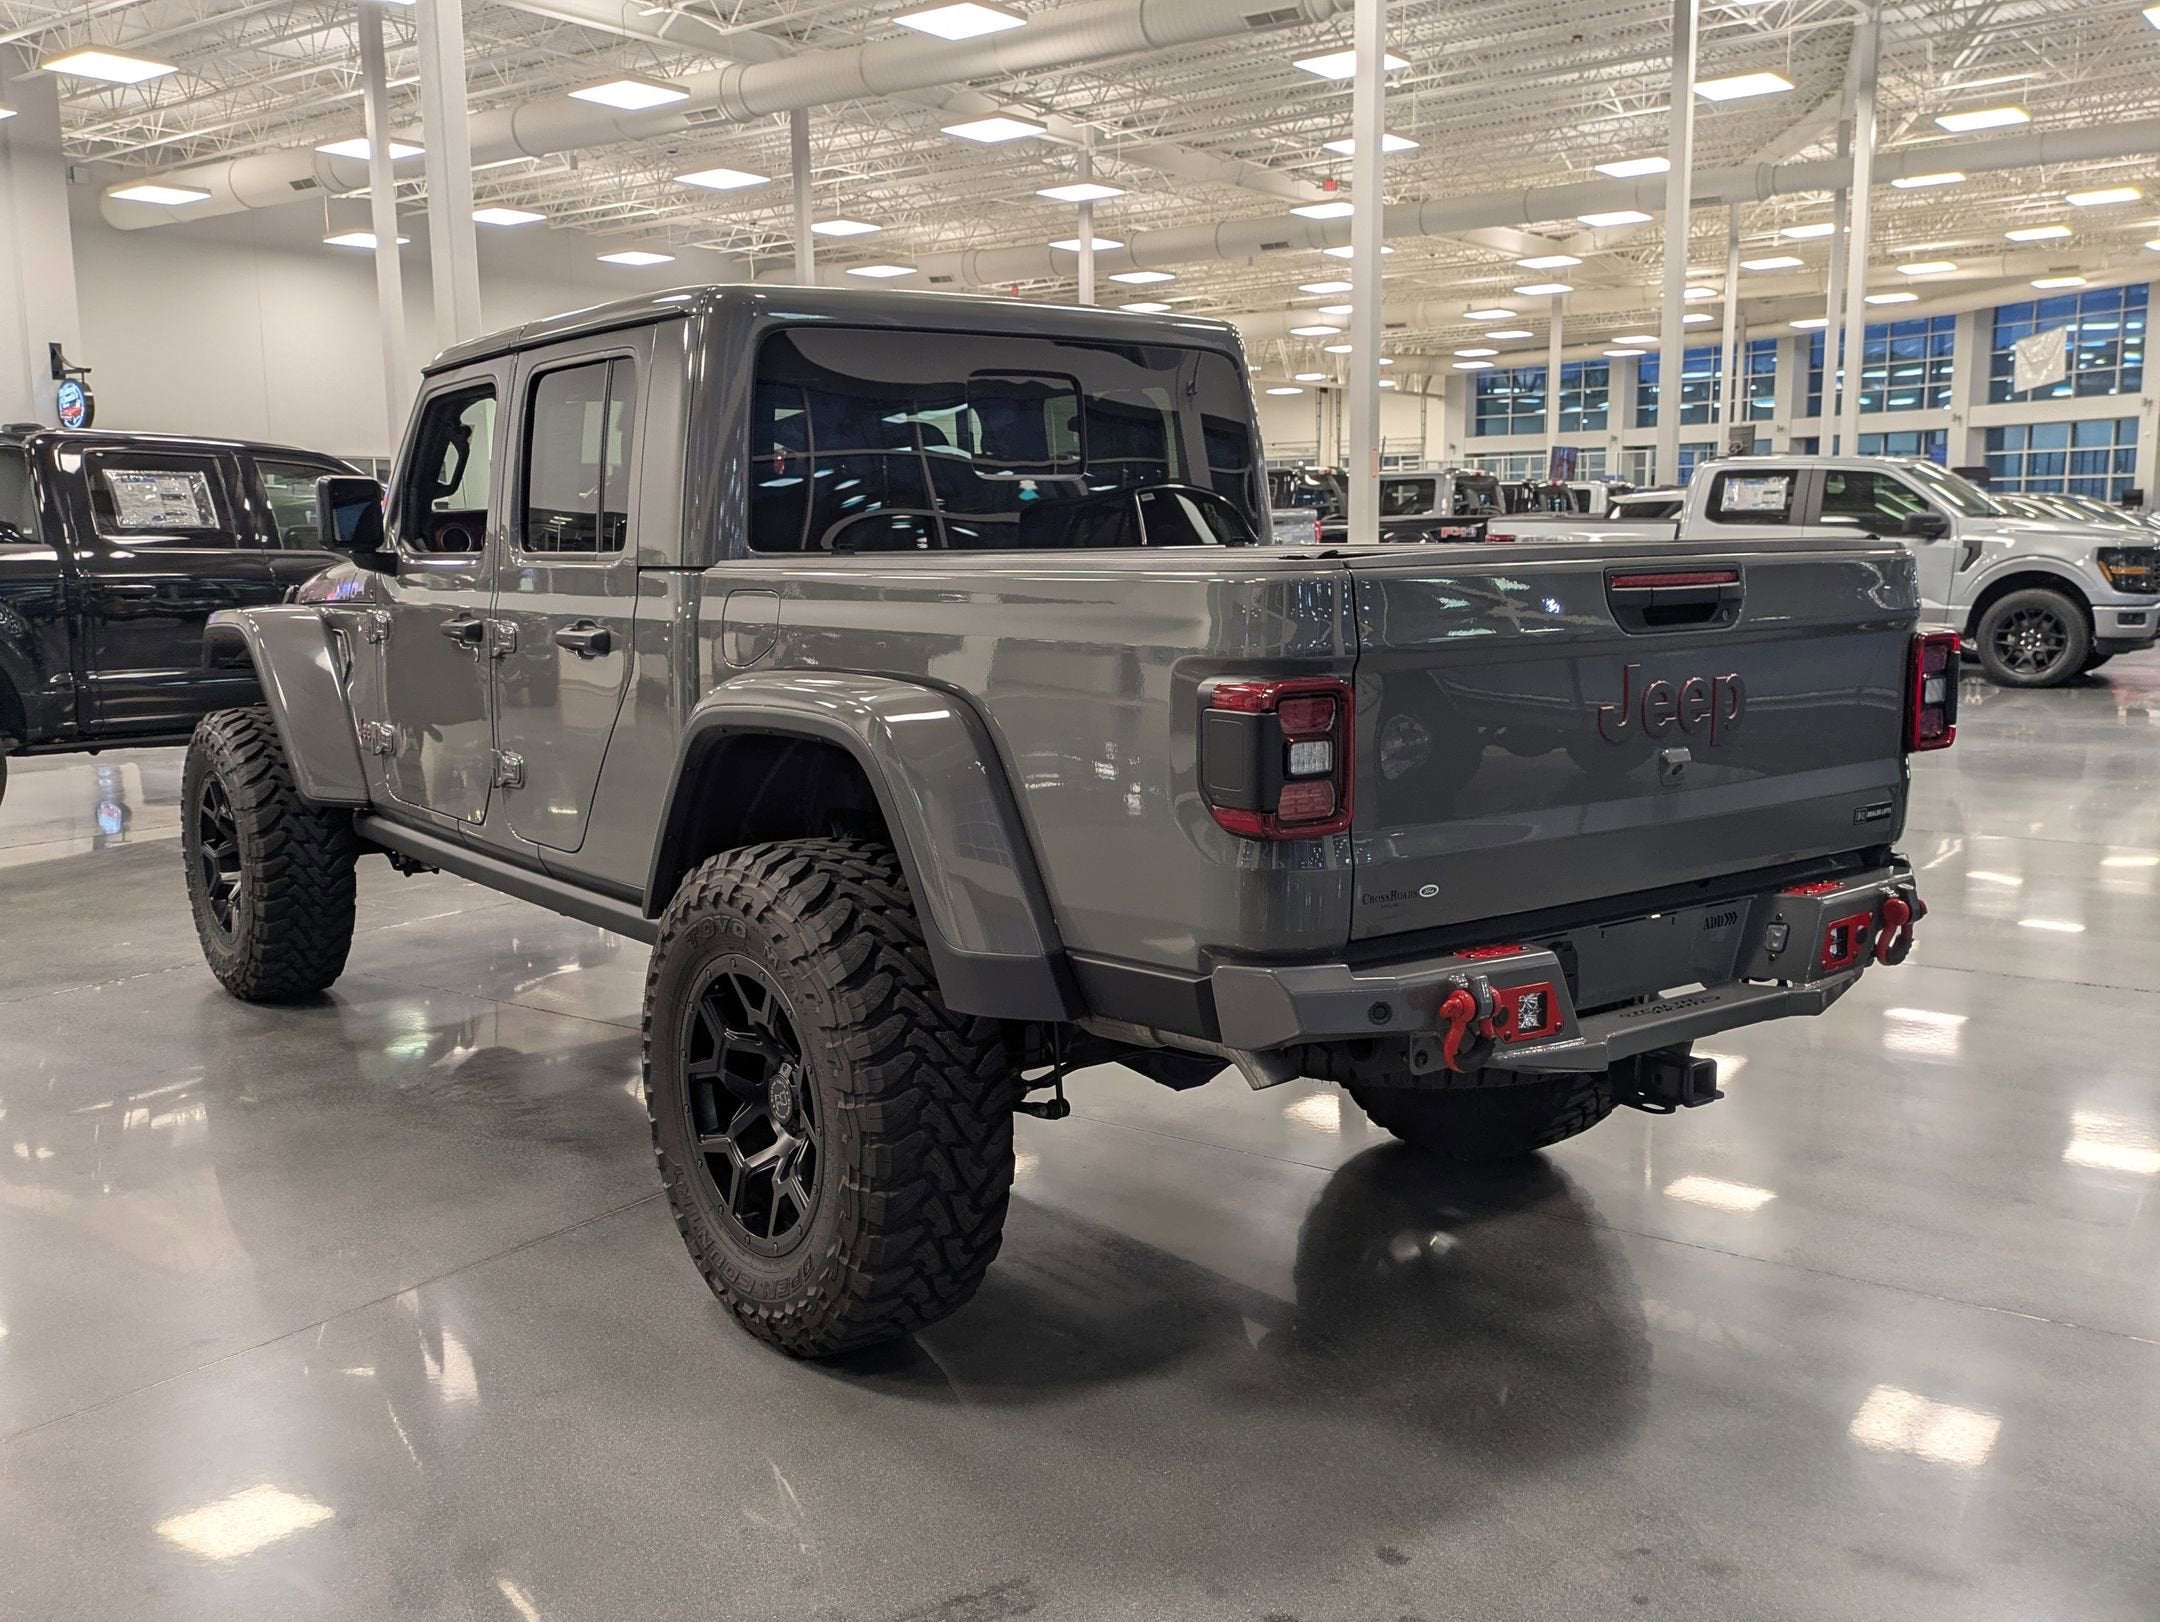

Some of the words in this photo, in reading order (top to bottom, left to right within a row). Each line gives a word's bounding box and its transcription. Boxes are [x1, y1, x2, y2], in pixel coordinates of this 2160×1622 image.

[1598, 664, 1746, 747] Jeep
[685, 914, 747, 947] TOYO
[1703, 914, 1725, 931] ADD
[664, 1155, 757, 1293] COUNTRY
[760, 1252, 815, 1300] OPEN
